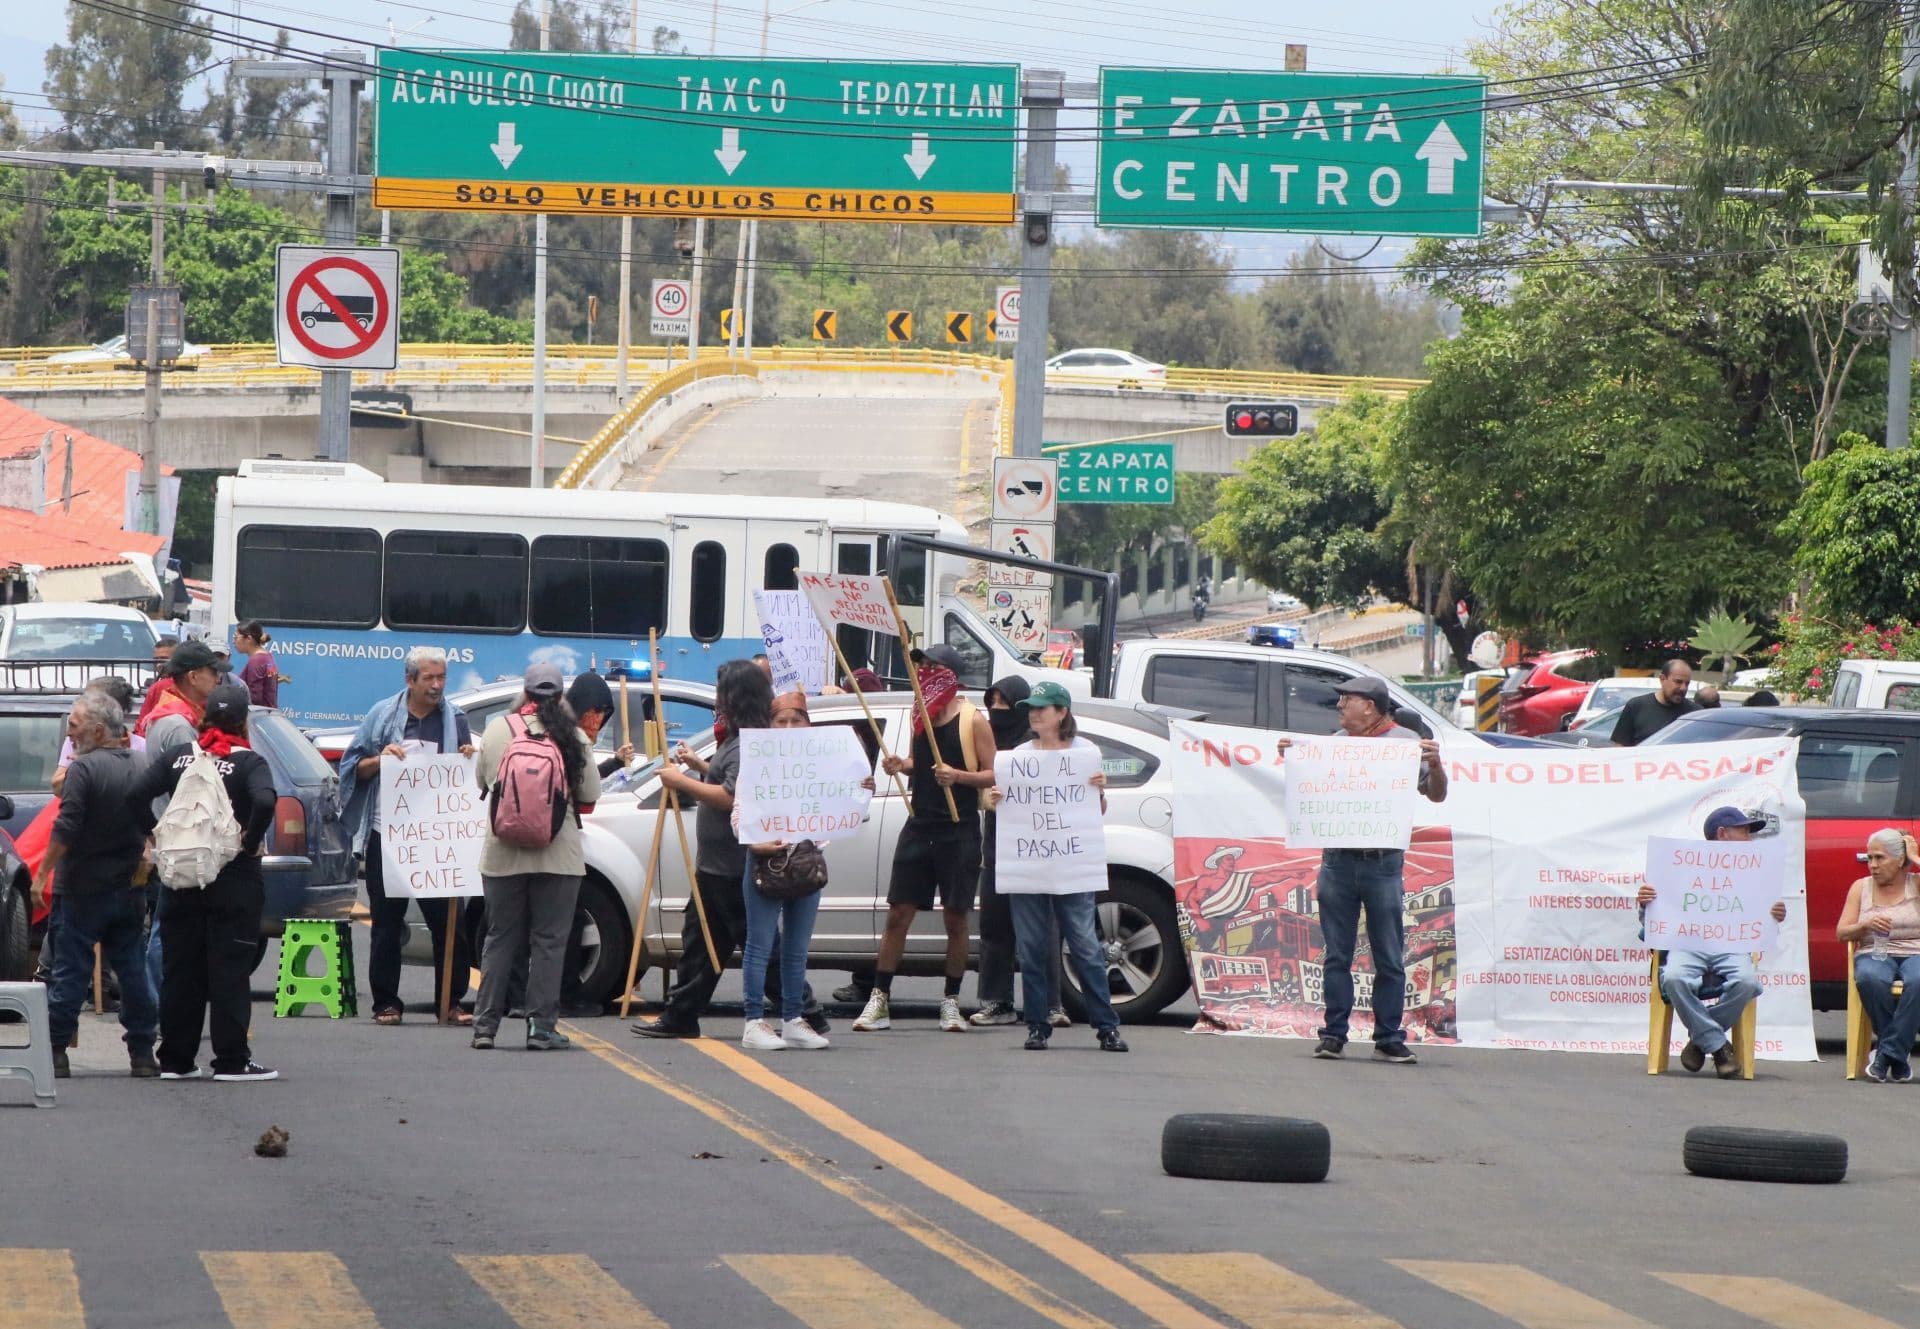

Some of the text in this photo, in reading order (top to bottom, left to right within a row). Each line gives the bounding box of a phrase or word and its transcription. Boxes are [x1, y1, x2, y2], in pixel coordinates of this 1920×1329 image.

[392, 69, 625, 108] ACAPULCO Cuota
[677, 76, 787, 114] TAXCO
[839, 80, 1004, 118] TEPOZTLAN
[1114, 96, 1402, 143] E ZAPATA
[1112, 158, 1401, 207] CENTRO
[456, 184, 935, 214] SOLO VEHICULOS CHICOS
[662, 290, 681, 304] 40
[652, 322, 688, 333] MAXIMA
[1058, 452, 1169, 470] E ZAPATA
[1058, 476, 1169, 494] CENTRO
[304, 711, 350, 721] CUERNAVACA
[1297, 744, 1323, 761] SIN
[1332, 744, 1418, 761] RESPUESTA
[394, 764, 465, 789] APOYO
[760, 762, 817, 780] A LOS
[1010, 756, 1040, 779] NO
[1057, 756, 1077, 777] AL
[1328, 765, 1368, 779] A LA
[1547, 763, 1624, 785] DEL
[1391, 778, 1409, 790] DE
[394, 792, 472, 815] A LOS
[1005, 784, 1086, 805] AUMENTO
[800, 801, 821, 815] DE
[1300, 800, 1392, 815] REDUCTORES
[388, 819, 488, 842] MAESTROS
[760, 812, 861, 833] VELOCIDAD
[1032, 812, 1072, 832] DEL
[1290, 822, 1302, 834] DE
[398, 845, 457, 865] DE LA
[1017, 836, 1083, 859] PASAJE
[1672, 849, 1761, 870] SOLUCION
[410, 868, 466, 890] CNTE
[1539, 870, 1554, 882] EL
[1557, 870, 1630, 884] TRASPORTE
[1692, 876, 1733, 890] A LA
[1529, 892, 1582, 909] INTERÉS
[1585, 896, 1632, 909] SOCIAL
[1682, 893, 1744, 912] PODA
[1649, 921, 1762, 941] DE ARBOLES
[1504, 945, 1592, 962] ESTATIZACIÓN
[1595, 949, 1619, 962] DEL
[1480, 973, 1520, 985] ESTADO
[1524, 973, 1552, 985] TIENE
[1555, 974, 1568, 986] LA
[1570, 973, 1636, 987] OBLIGACIÓN
[1774, 975, 1785, 986] SI
[1786, 975, 1806, 986] LOS
[1550, 991, 1647, 1004] CONCESIONARIOS
